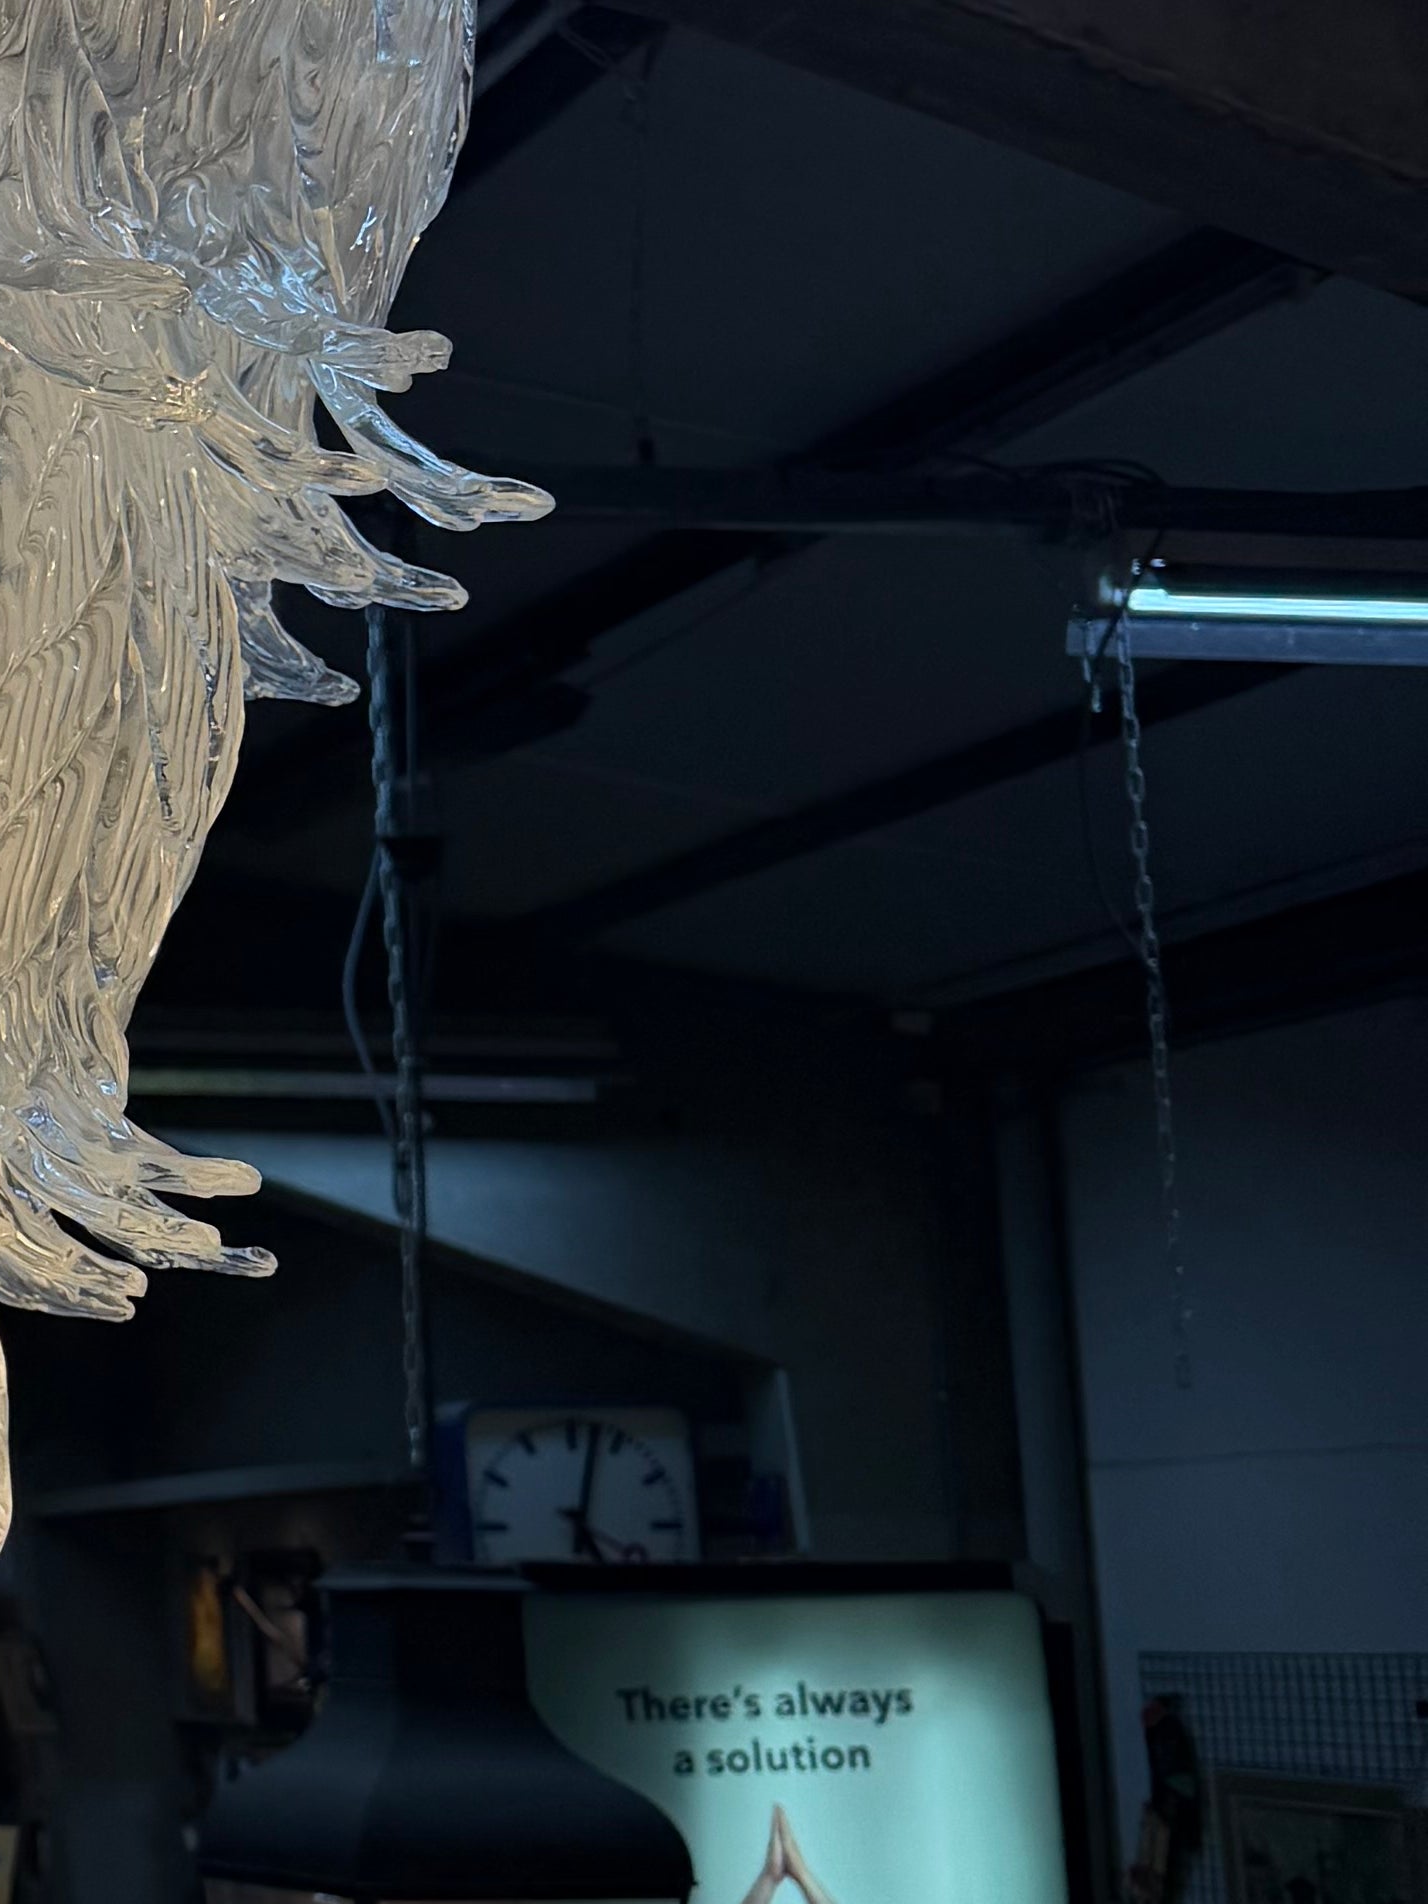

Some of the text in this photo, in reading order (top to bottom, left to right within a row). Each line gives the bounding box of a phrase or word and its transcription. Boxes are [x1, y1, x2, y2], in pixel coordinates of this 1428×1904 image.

[615, 1681, 913, 1725] There's always
[672, 1737, 871, 1776] a solution
